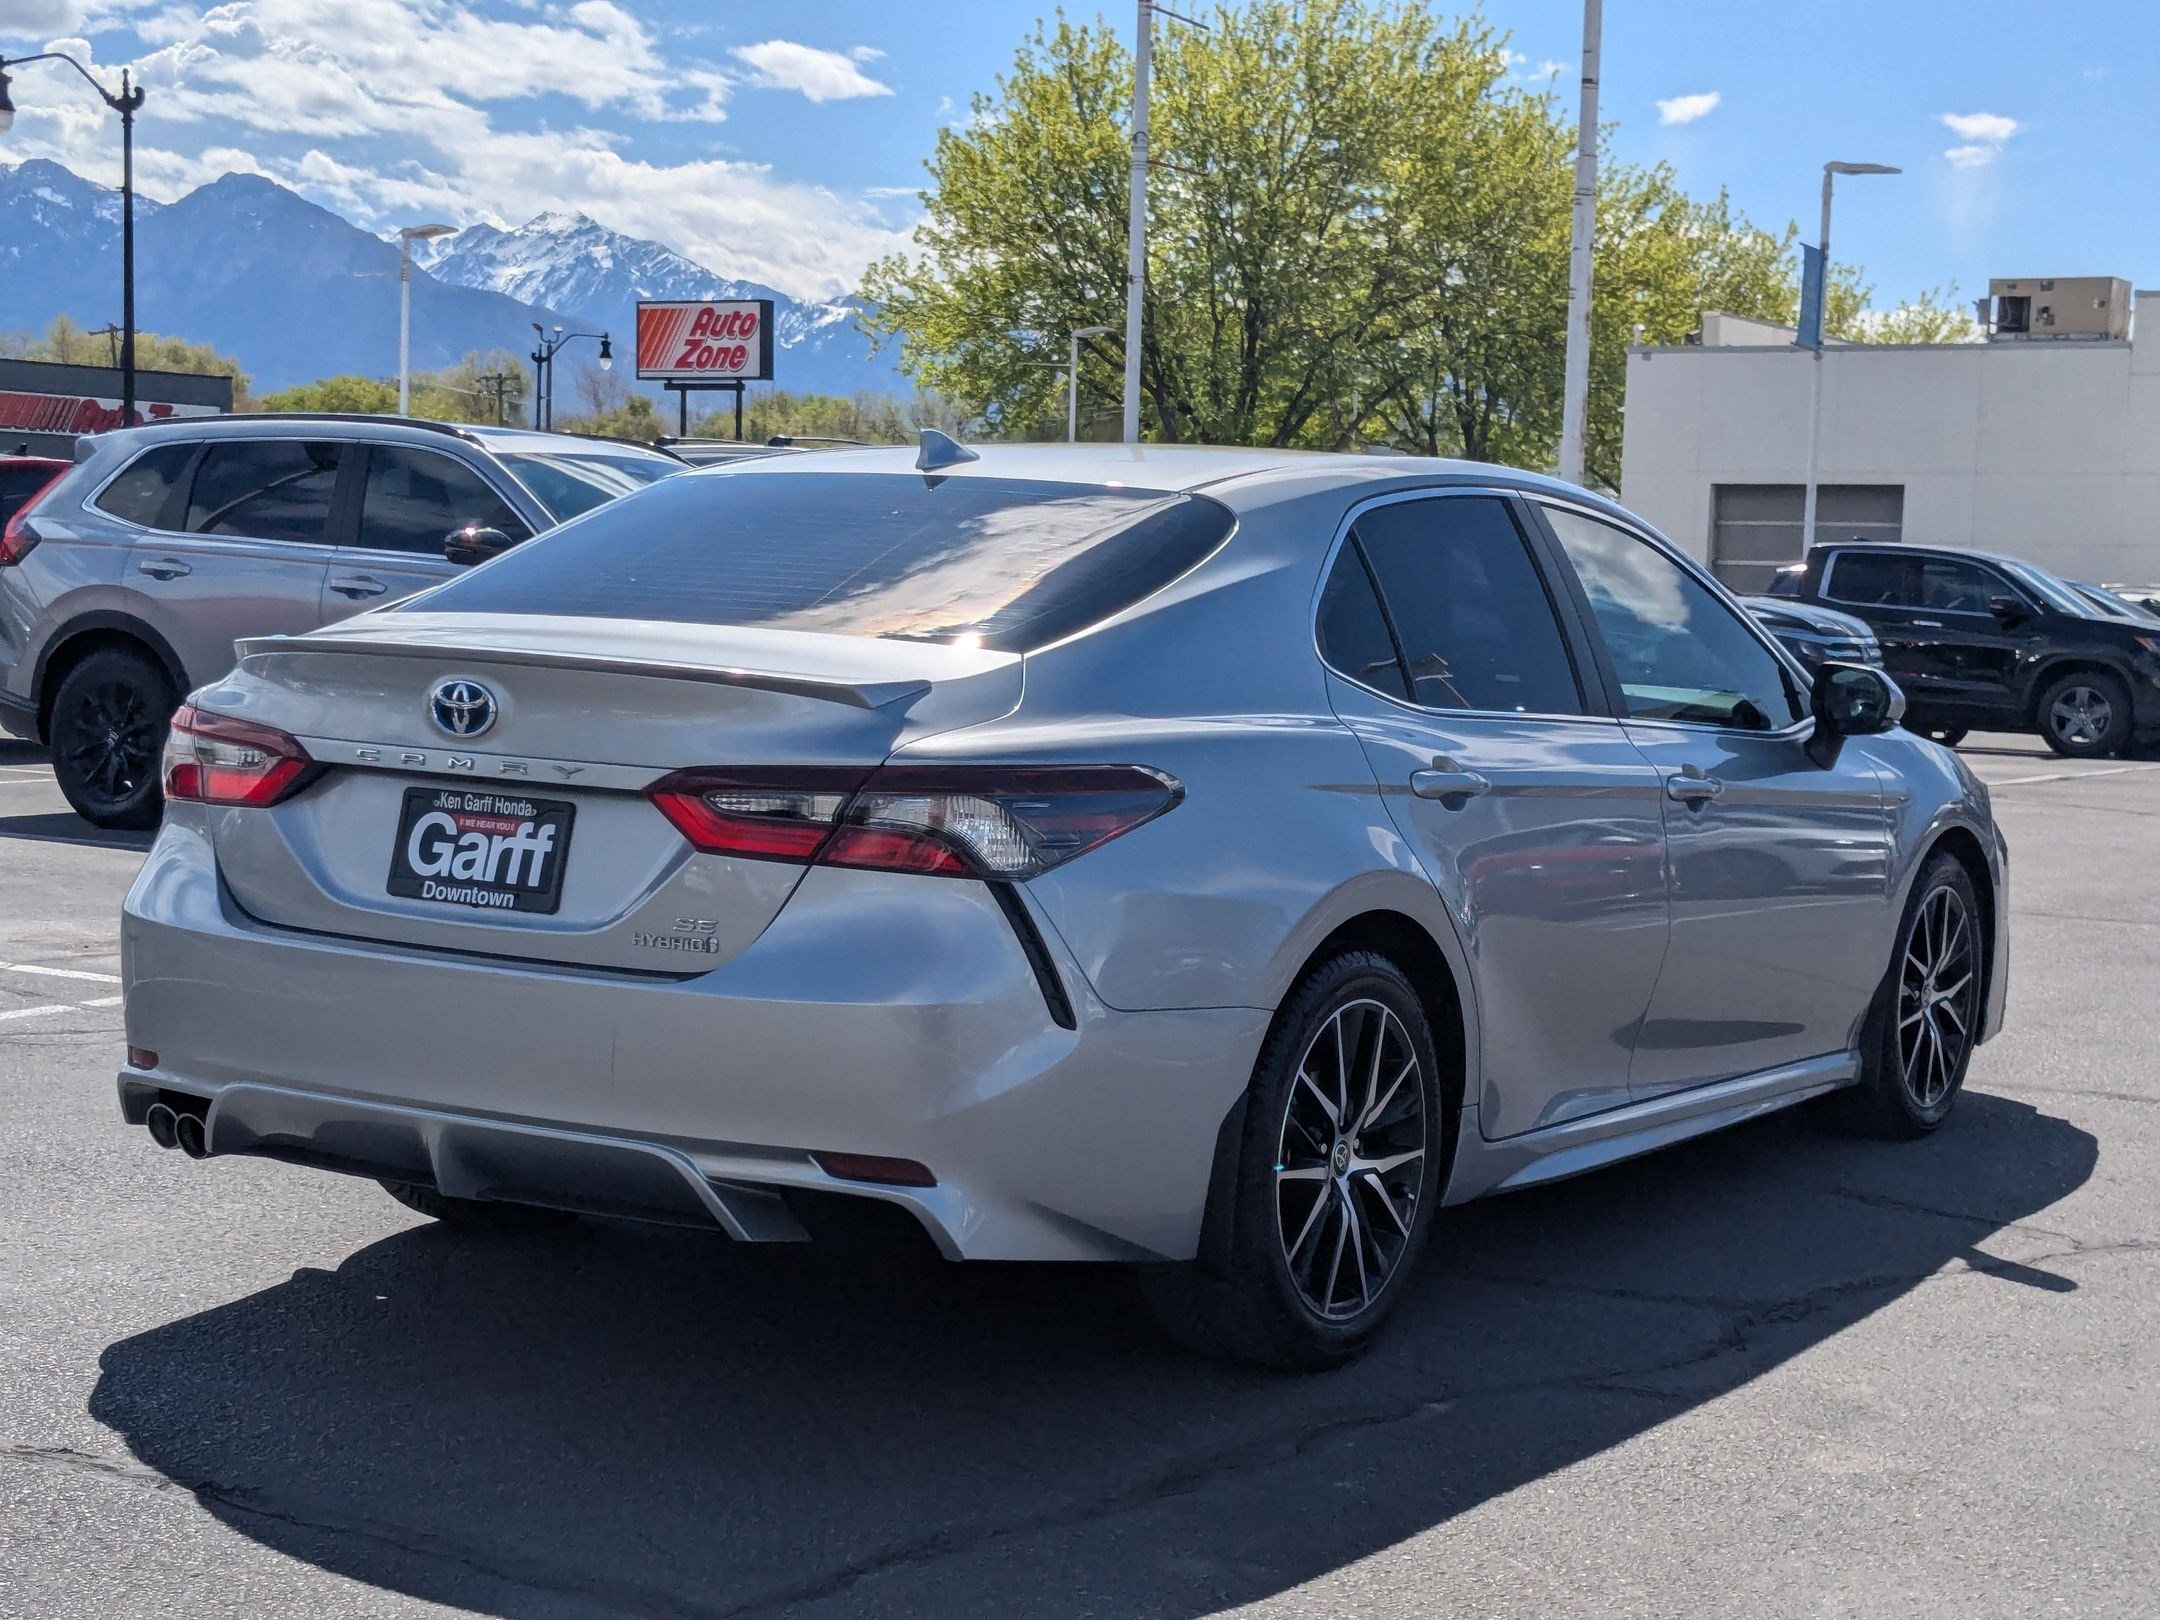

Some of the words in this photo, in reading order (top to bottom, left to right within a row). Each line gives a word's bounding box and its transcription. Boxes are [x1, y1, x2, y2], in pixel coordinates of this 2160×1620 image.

[689, 307, 757, 337] Auto
[674, 339, 747, 369] Zone
[357, 749, 585, 779] CAMRY
[440, 792, 461, 809] Ken
[464, 794, 493, 812] Garff
[495, 797, 532, 816] Honda
[465, 819, 476, 827] WE
[497, 822, 511, 831] YOU
[408, 811, 556, 887] Garff
[422, 881, 515, 908] Downtown
[673, 917, 719, 934] SE
[632, 932, 706, 953] HYBRID
